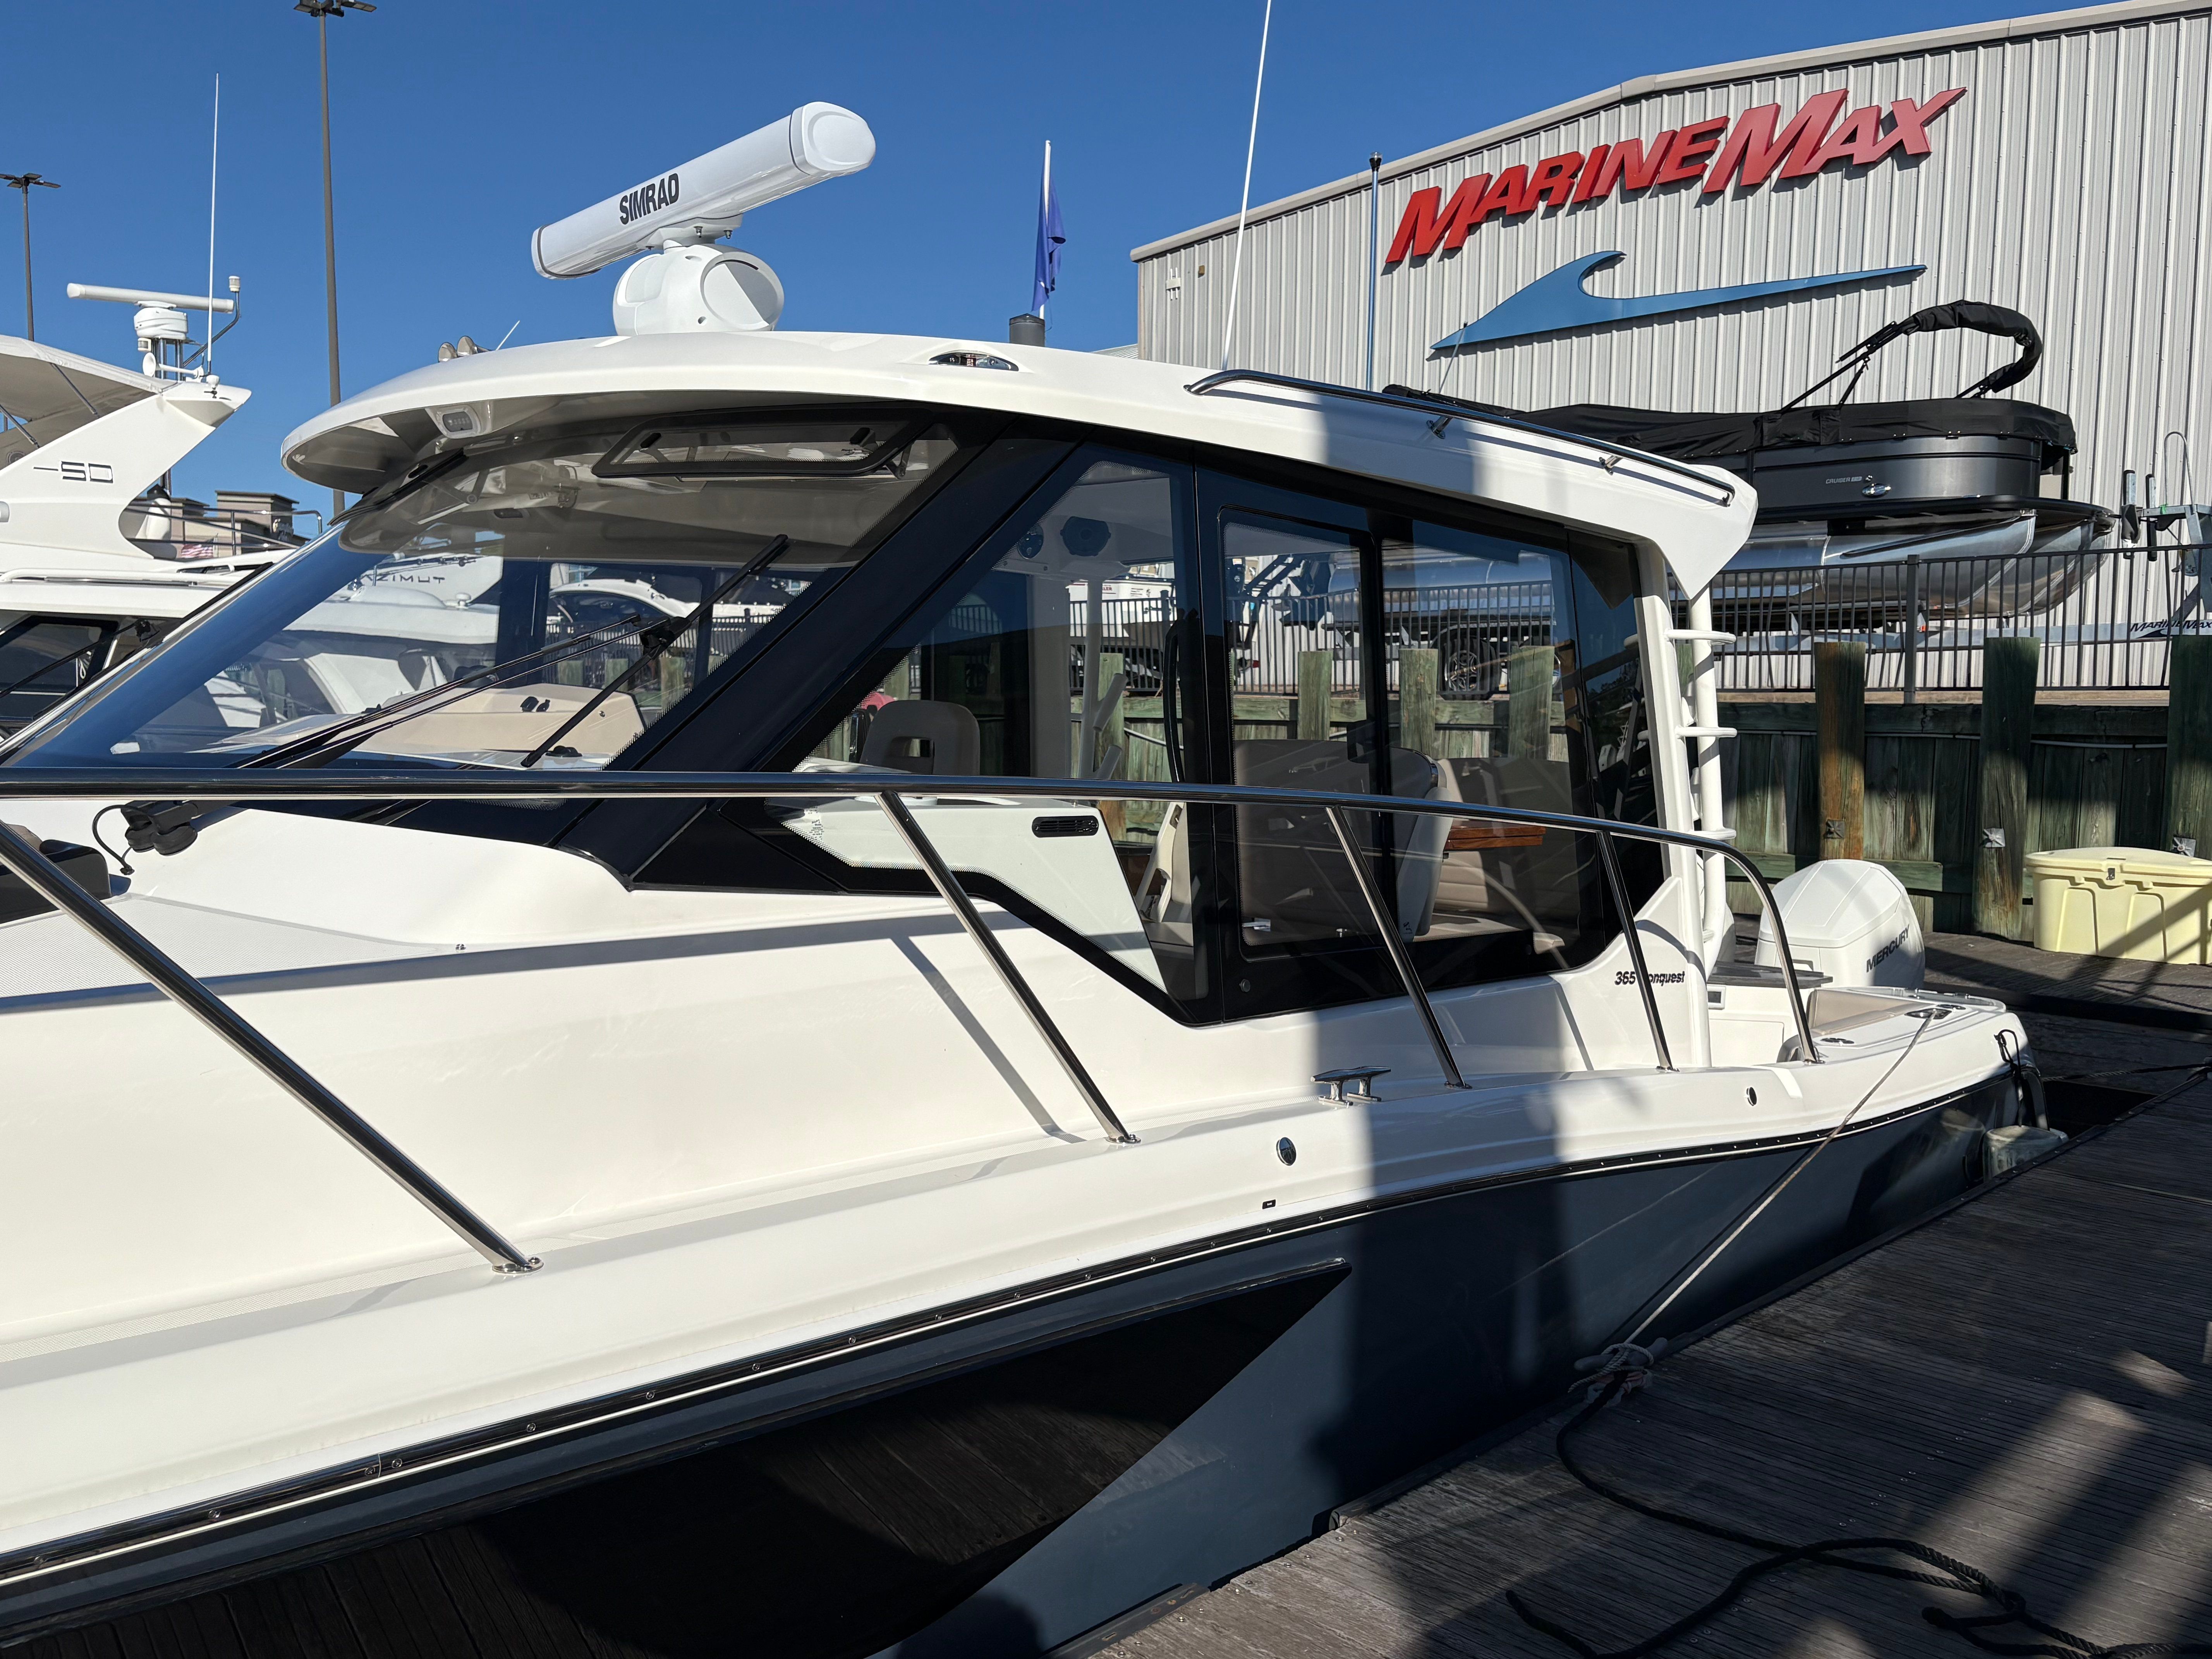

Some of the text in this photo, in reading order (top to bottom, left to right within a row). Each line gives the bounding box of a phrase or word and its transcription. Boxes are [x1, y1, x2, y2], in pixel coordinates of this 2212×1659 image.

[620, 173, 679, 225] SIMRAD
[360, 574, 445, 584] AZIMUT
[1867, 923, 1910, 973] MERCURY
[1614, 971, 1685, 986] 365 onquest
